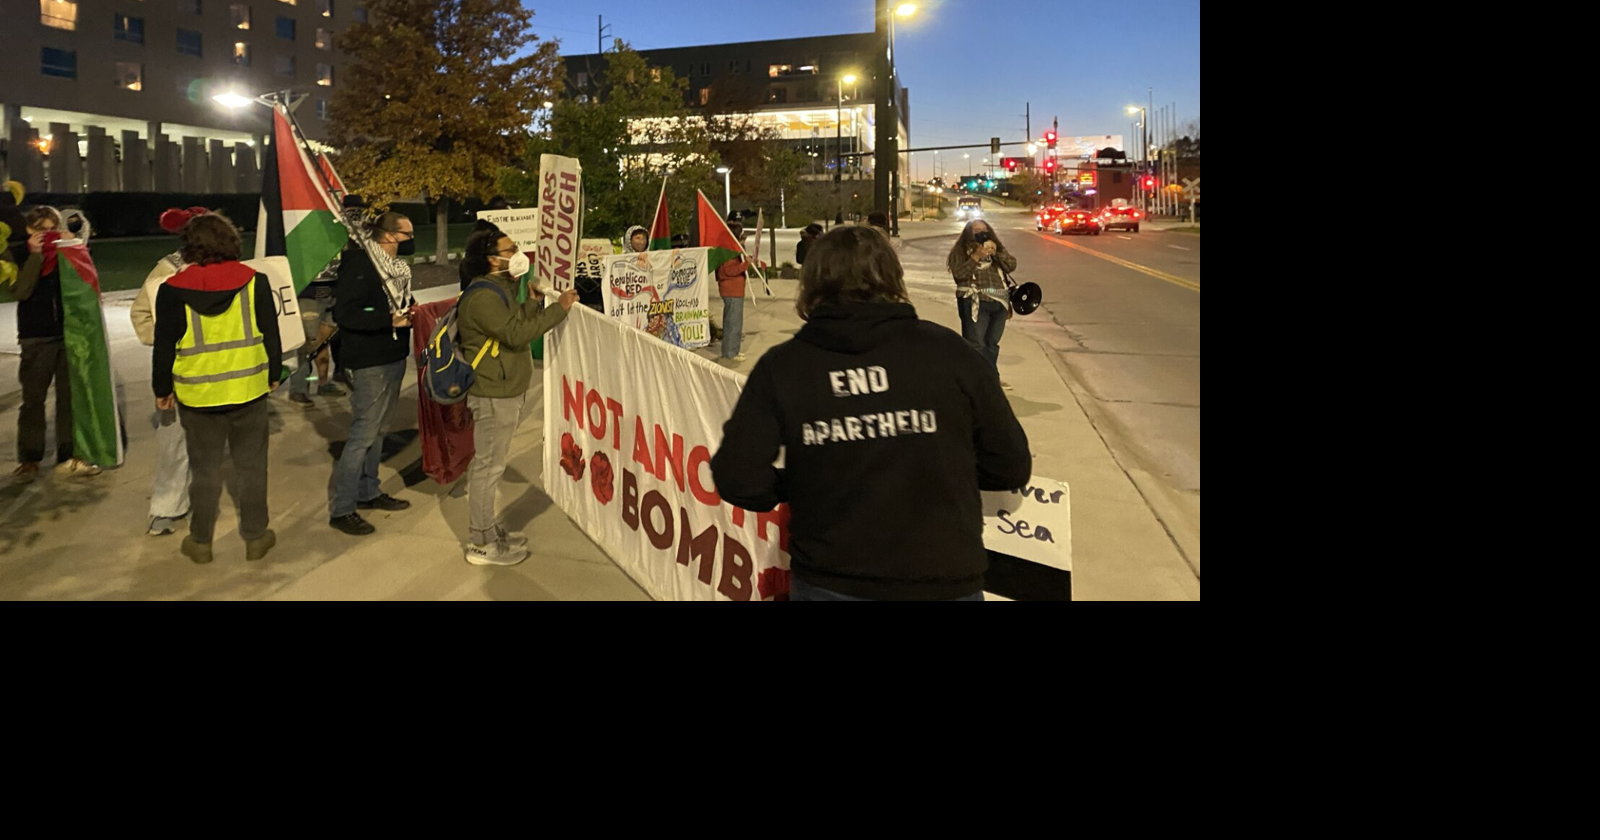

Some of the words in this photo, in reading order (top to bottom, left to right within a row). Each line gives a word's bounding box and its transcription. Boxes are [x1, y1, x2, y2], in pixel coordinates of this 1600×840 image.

[540, 171, 557, 240] YEARS
[553, 171, 577, 293] ENOUGH
[538, 245, 552, 281] 75
[609, 271, 648, 288] Republican
[625, 284, 642, 295] RED
[636, 301, 648, 314] the
[649, 299, 674, 315] ZIONIST
[681, 323, 704, 342] YOU!
[829, 366, 889, 397] END
[563, 375, 624, 450] NOT
[802, 409, 937, 446] APARTHEID
[1011, 485, 1066, 504] ver
[622, 467, 753, 602] BOMB
[997, 509, 1055, 544] Sea
